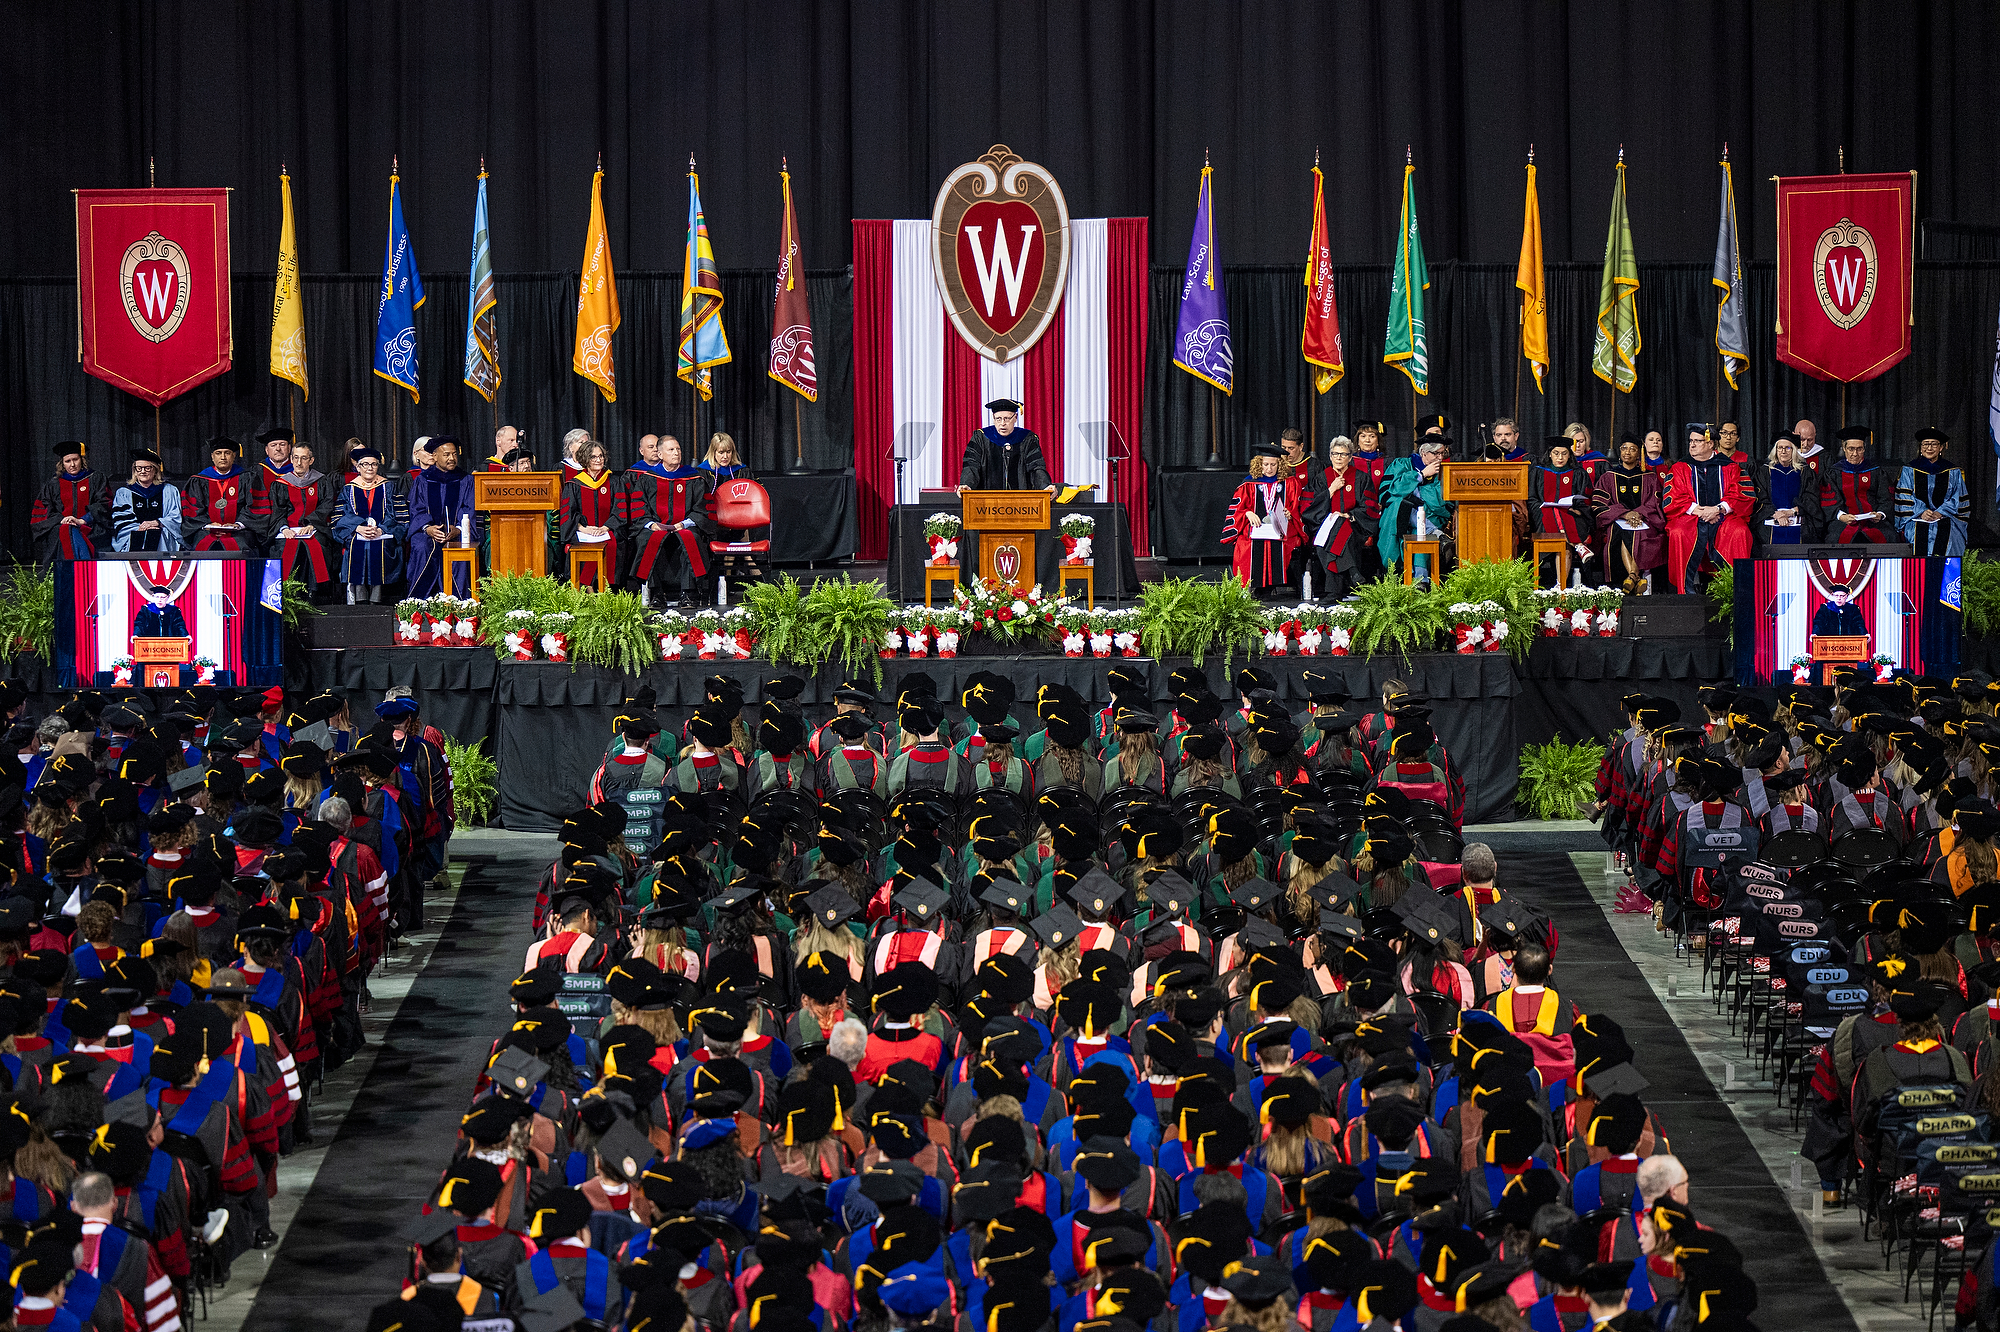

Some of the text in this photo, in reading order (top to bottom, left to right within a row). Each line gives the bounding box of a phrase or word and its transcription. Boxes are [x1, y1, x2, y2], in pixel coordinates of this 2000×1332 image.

[964, 218, 1037, 317] W
[1182, 244, 1208, 300] Law School
[1316, 246, 1329, 300] College of
[399, 277, 408, 293] 1900
[596, 276, 605, 292] 1857
[1828, 254, 1862, 306] W
[136, 268, 174, 320] W
[1320, 284, 1334, 318] Letters
[1456, 478, 1517, 486] WISCONSIN
[487, 488, 548, 496] WISCONSIN
[976, 506, 1039, 515] WISCONSIN
[1000, 555, 1014, 575] W
[630, 792, 660, 801] SMPH
[1744, 867, 1772, 880] NURS
[1750, 886, 1780, 899] NURS
[1767, 907, 1798, 915] NURS
[1782, 925, 1814, 934] NURS
[1800, 952, 1824, 960] EDU
[1816, 972, 1840, 981] EDU
[565, 980, 600, 988] SMPH
[1835, 992, 1860, 1000] EDU
[1904, 1094, 1952, 1104] PHARM
[1922, 1120, 1971, 1132] PHARM
[1942, 1150, 1992, 1159] PHARM
